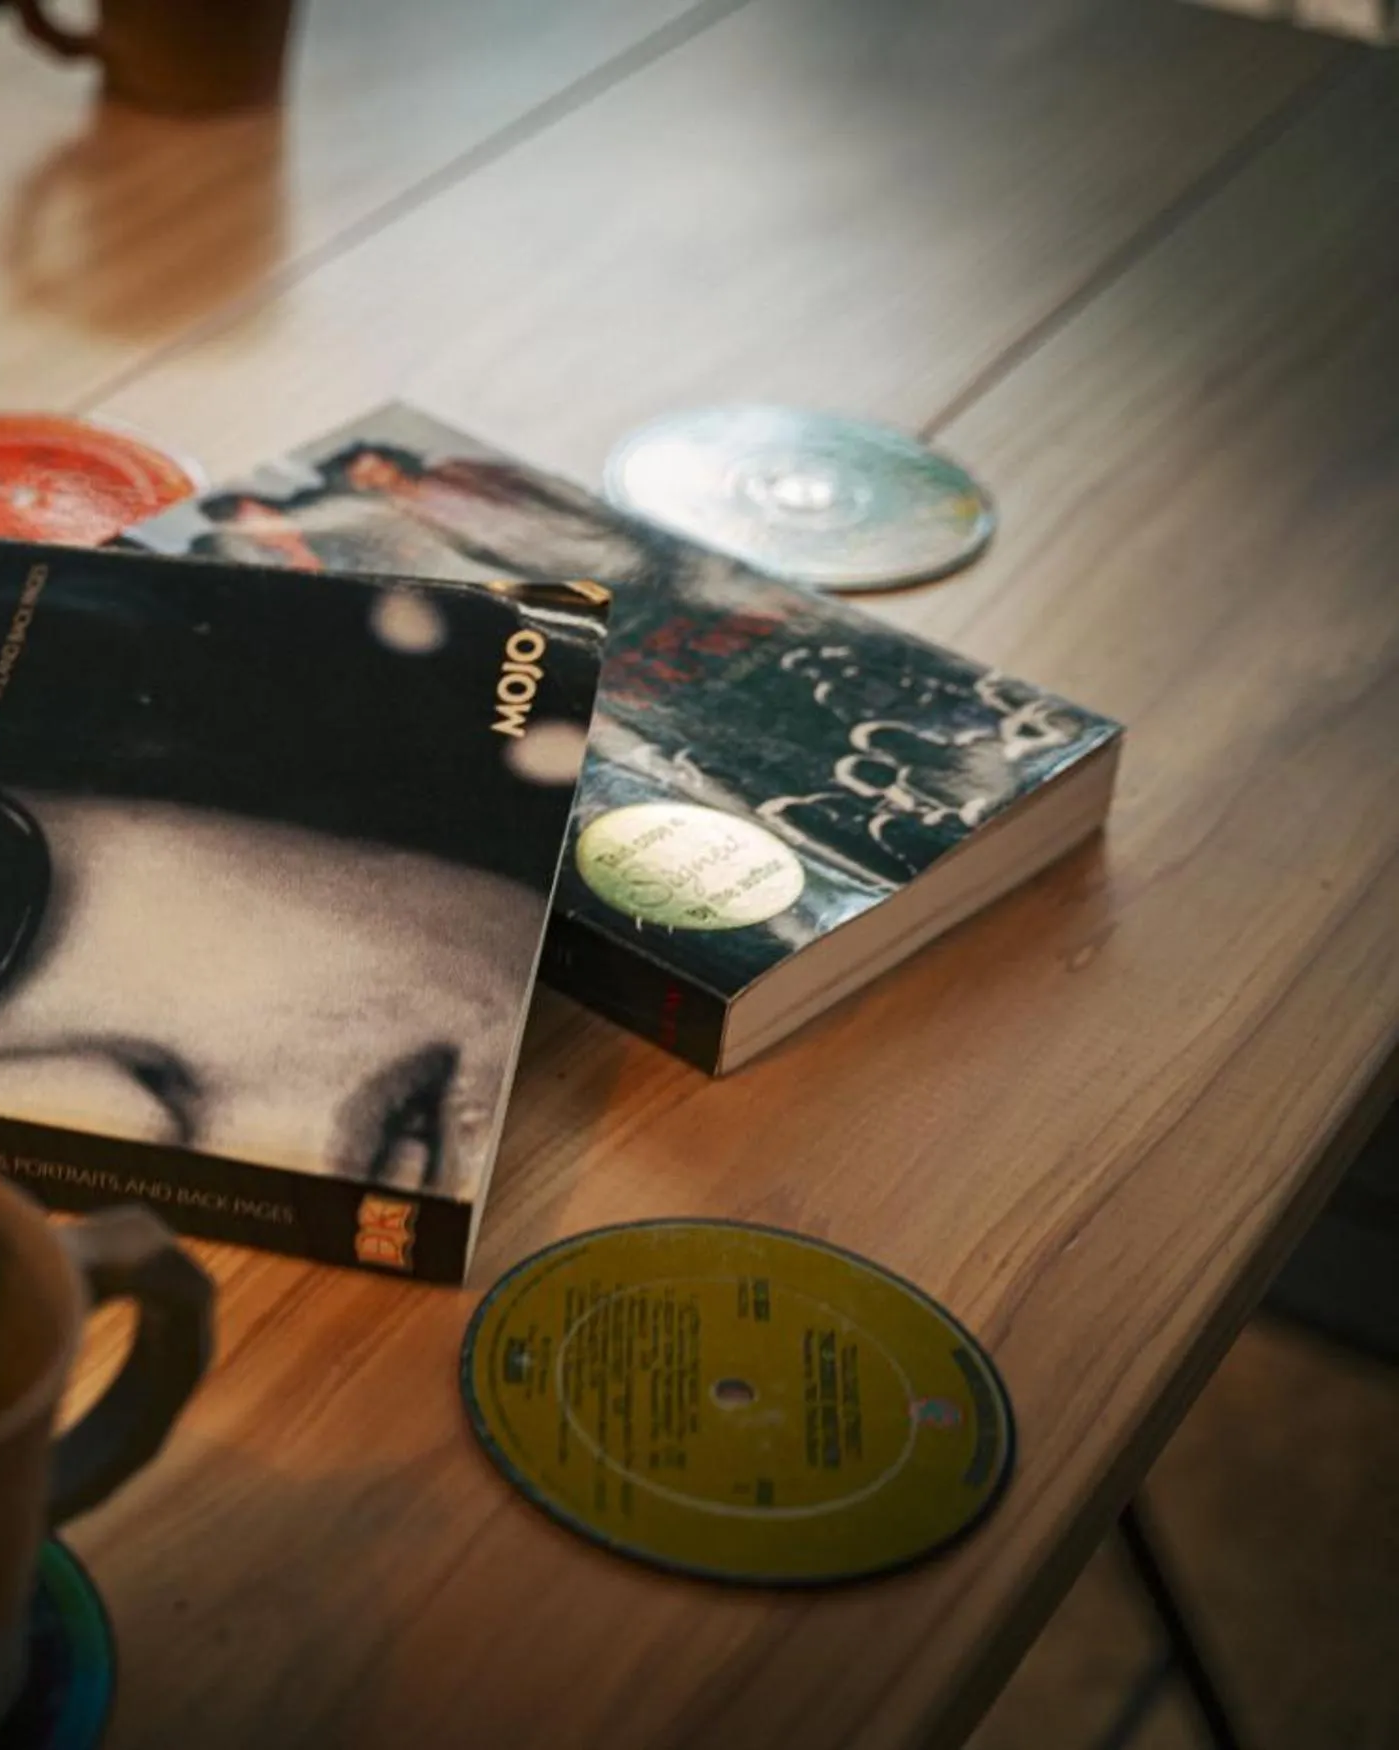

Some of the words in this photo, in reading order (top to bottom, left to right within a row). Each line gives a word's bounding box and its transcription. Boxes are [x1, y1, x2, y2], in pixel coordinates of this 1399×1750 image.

[491, 630, 546, 737] MOJO
[14, 1159, 119, 1191] PORTRAITS
[125, 1179, 172, 1202] AND
[177, 1188, 228, 1210] BACK
[233, 1197, 294, 1225] PAGES
